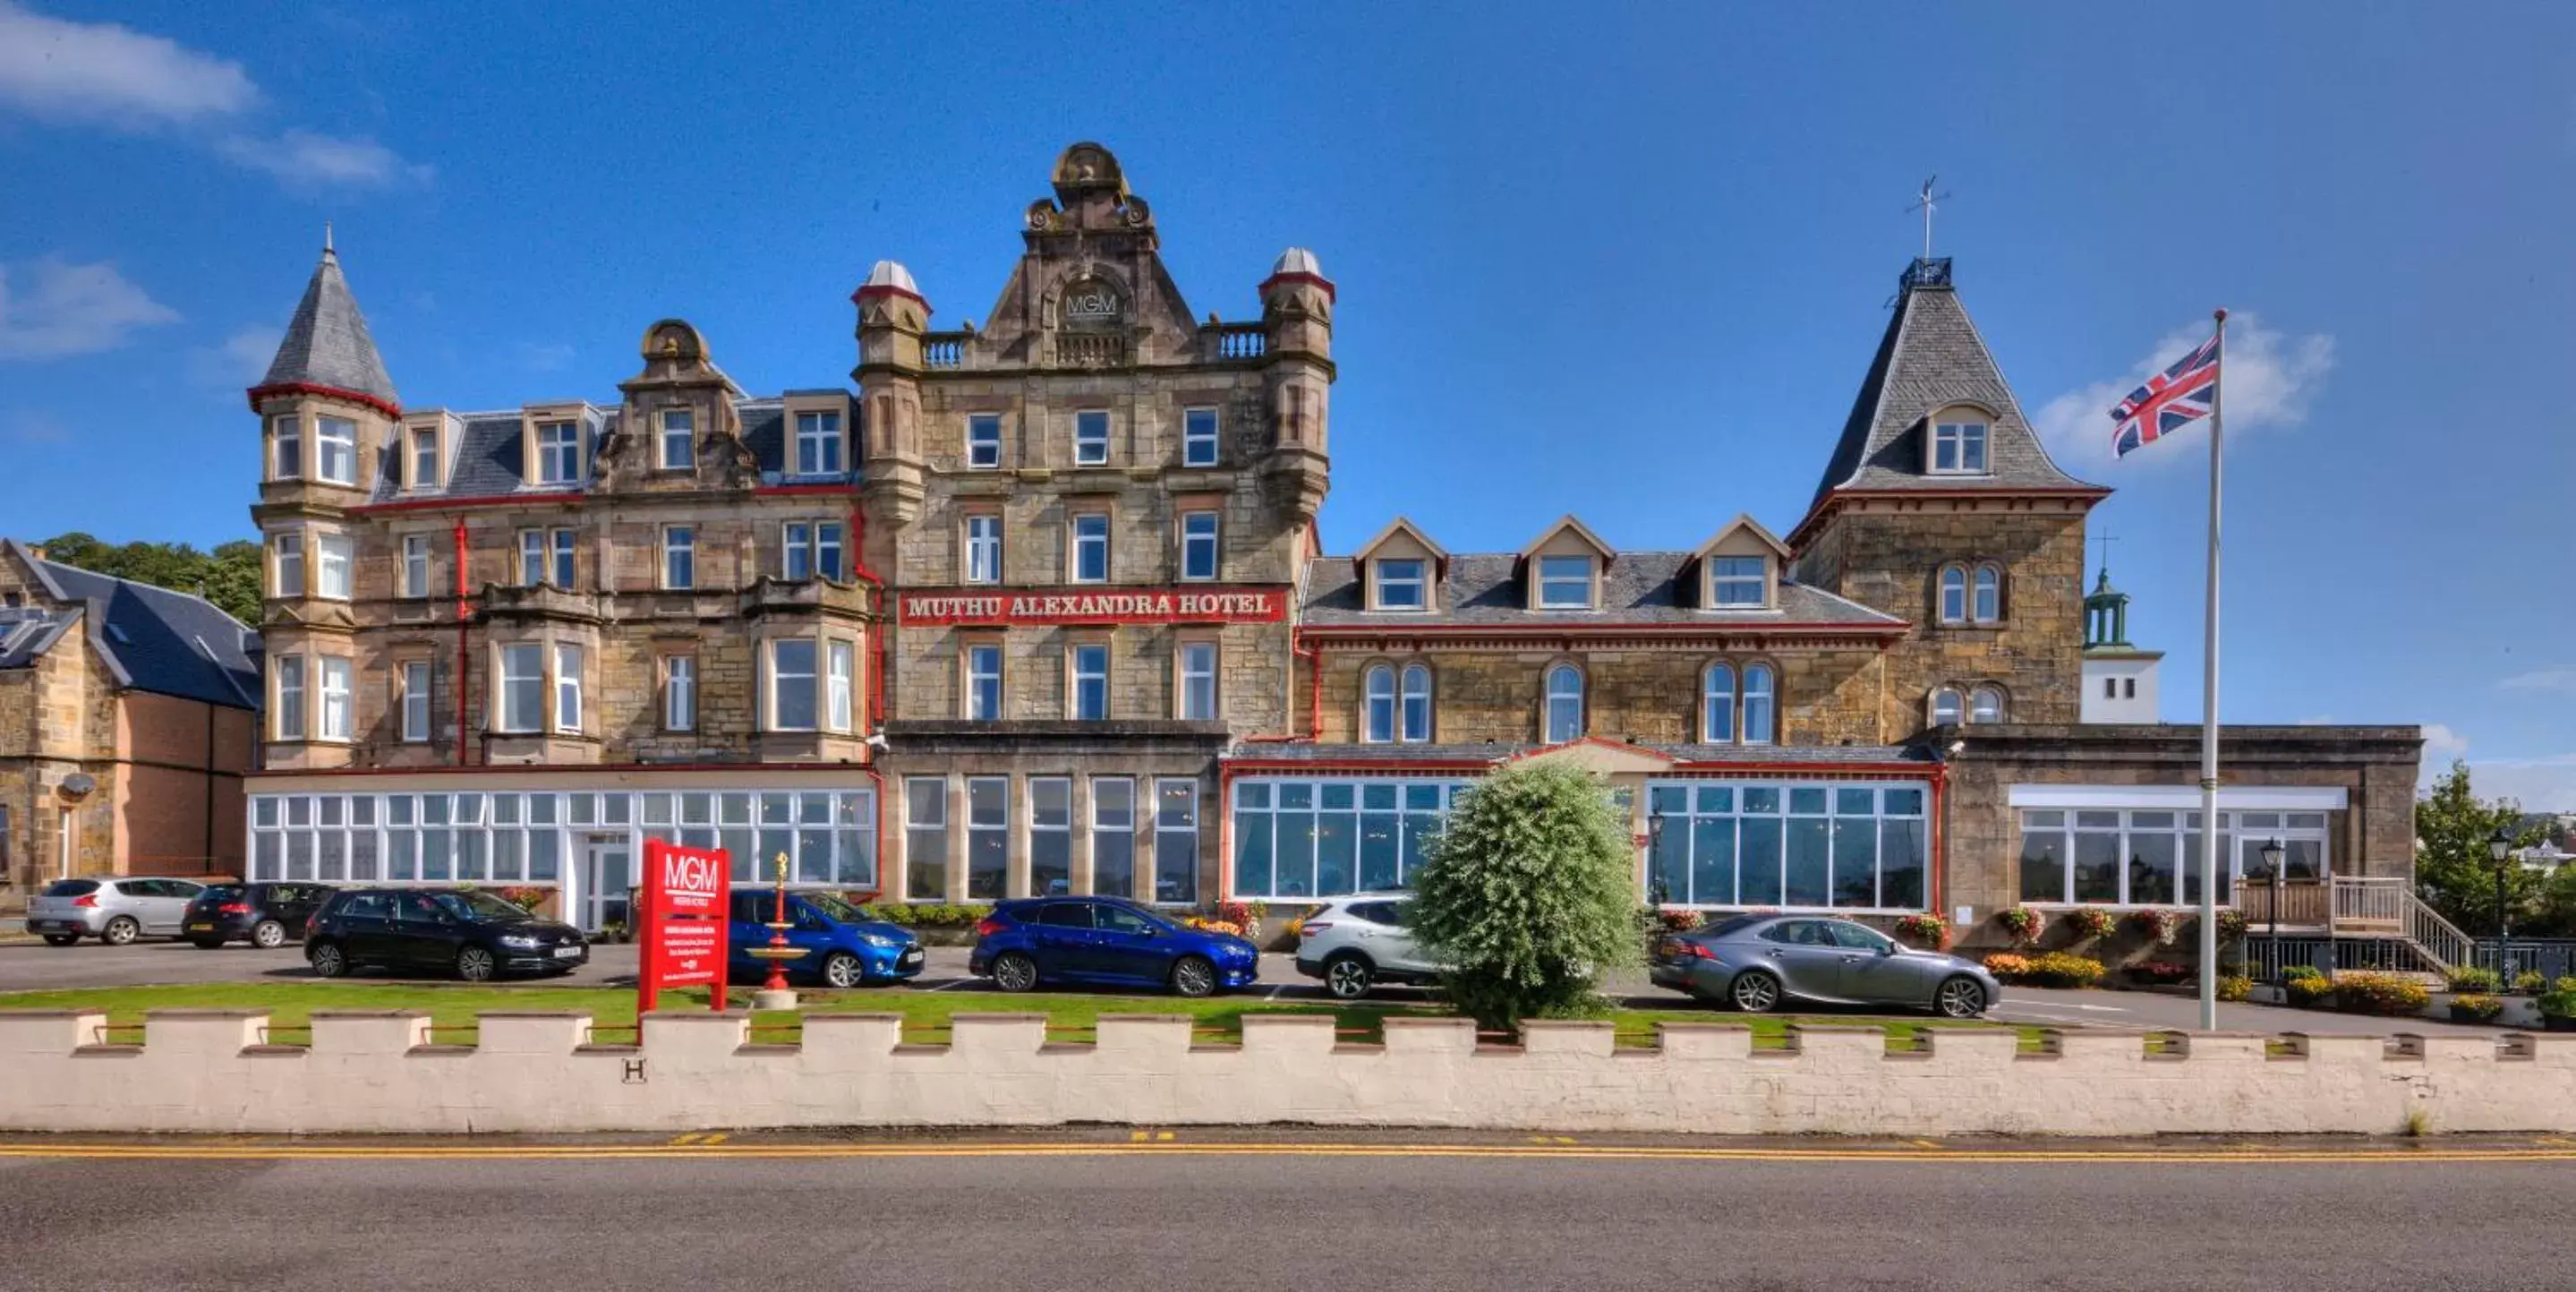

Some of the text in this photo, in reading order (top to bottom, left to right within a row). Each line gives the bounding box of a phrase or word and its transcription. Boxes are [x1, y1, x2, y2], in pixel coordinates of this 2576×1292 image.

[1065, 294, 1117, 313] MGM
[908, 593, 1272, 618] MUTHU ALEXANDRA HOTEL
[665, 852, 718, 892] MGM
[626, 1059, 644, 1080] H
